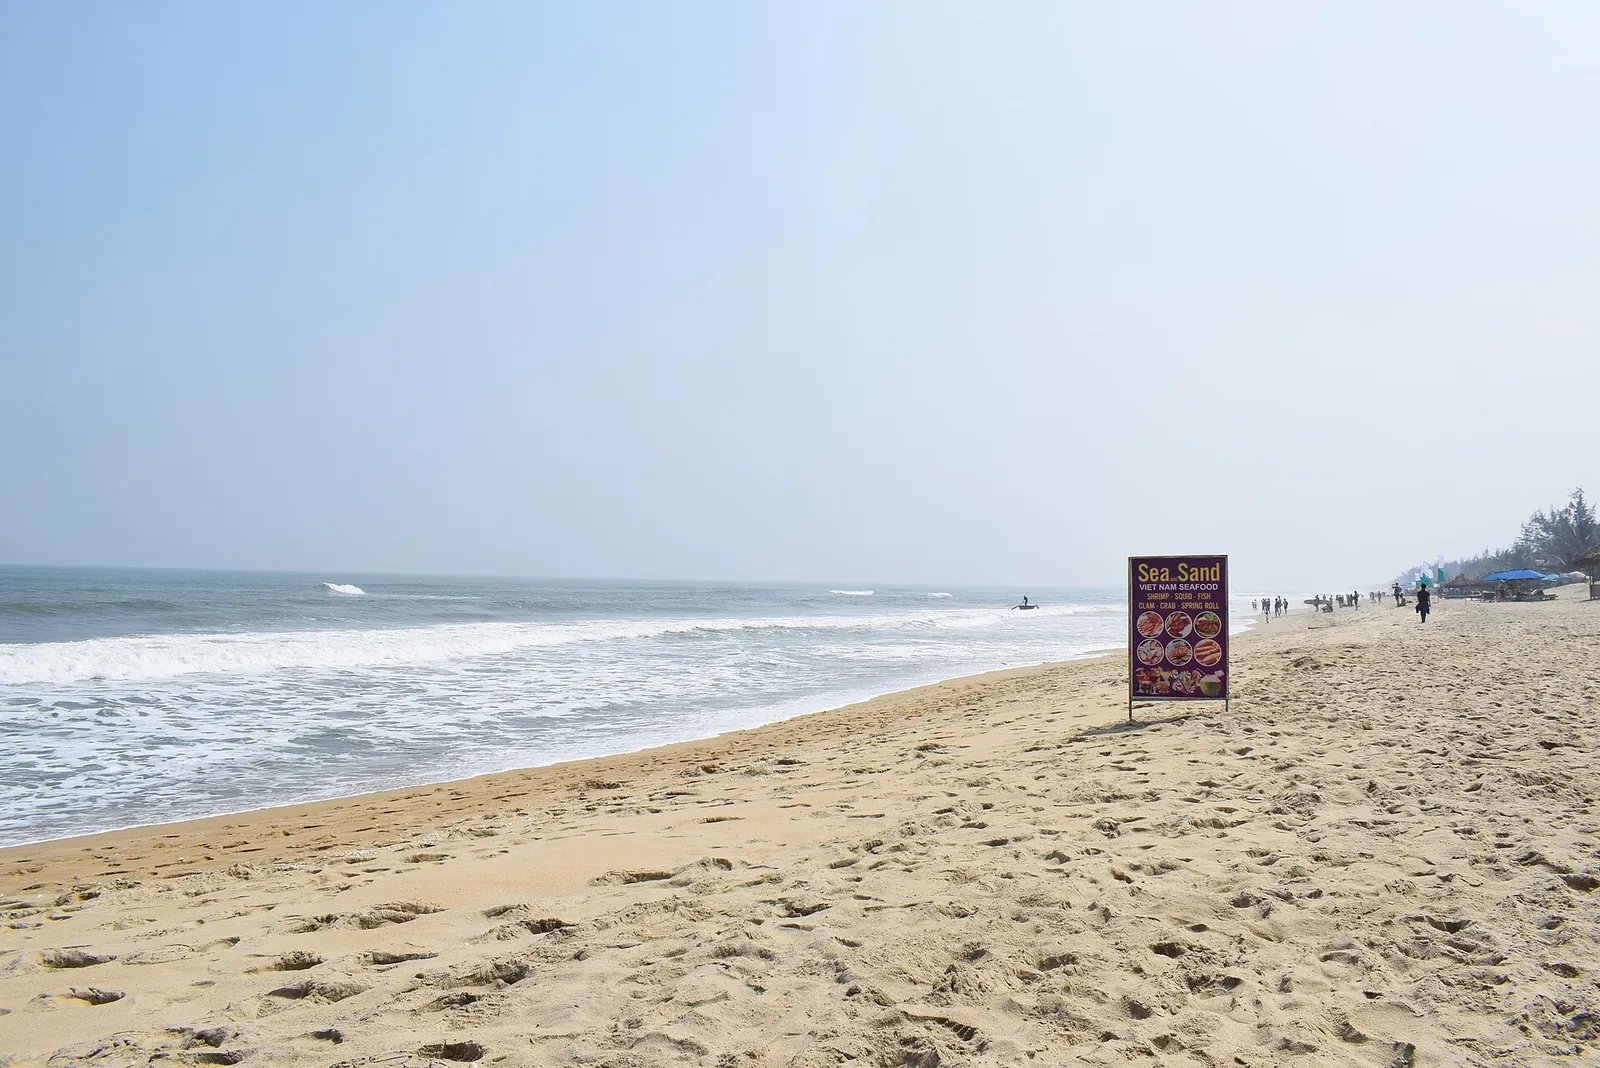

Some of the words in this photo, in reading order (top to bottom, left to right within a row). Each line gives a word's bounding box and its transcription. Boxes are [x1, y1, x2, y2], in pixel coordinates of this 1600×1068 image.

[1138, 563, 1169, 582] Sea
[1177, 562, 1220, 582] Sand
[1147, 592, 1170, 600] SHRIMP
[1174, 592, 1193, 600] SQUID
[1197, 592, 1211, 600] FISH
